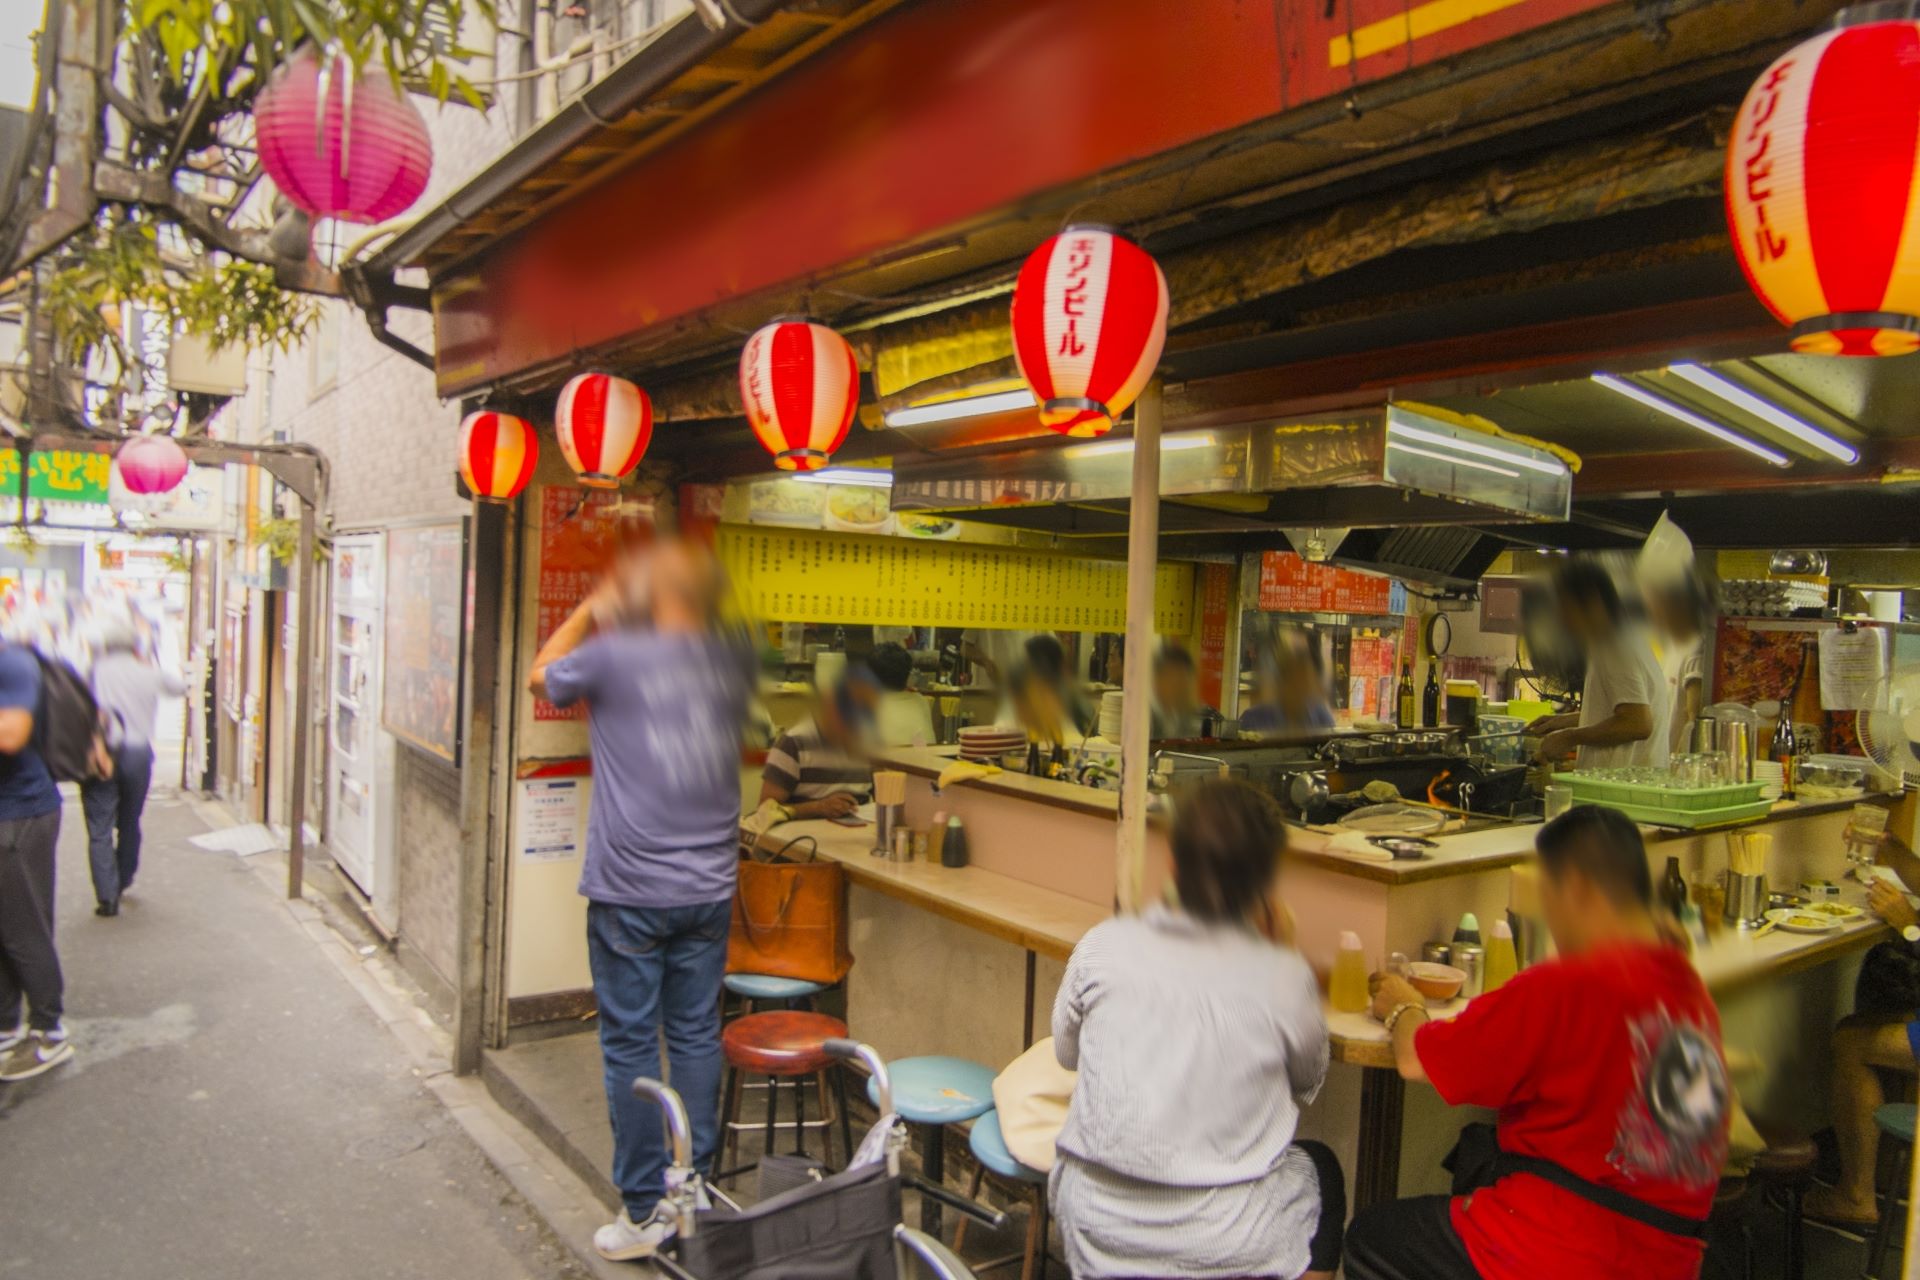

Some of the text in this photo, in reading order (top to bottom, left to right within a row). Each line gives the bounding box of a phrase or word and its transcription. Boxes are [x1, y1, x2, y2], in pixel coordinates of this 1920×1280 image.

[1058, 239, 1094, 356] キリンビール
